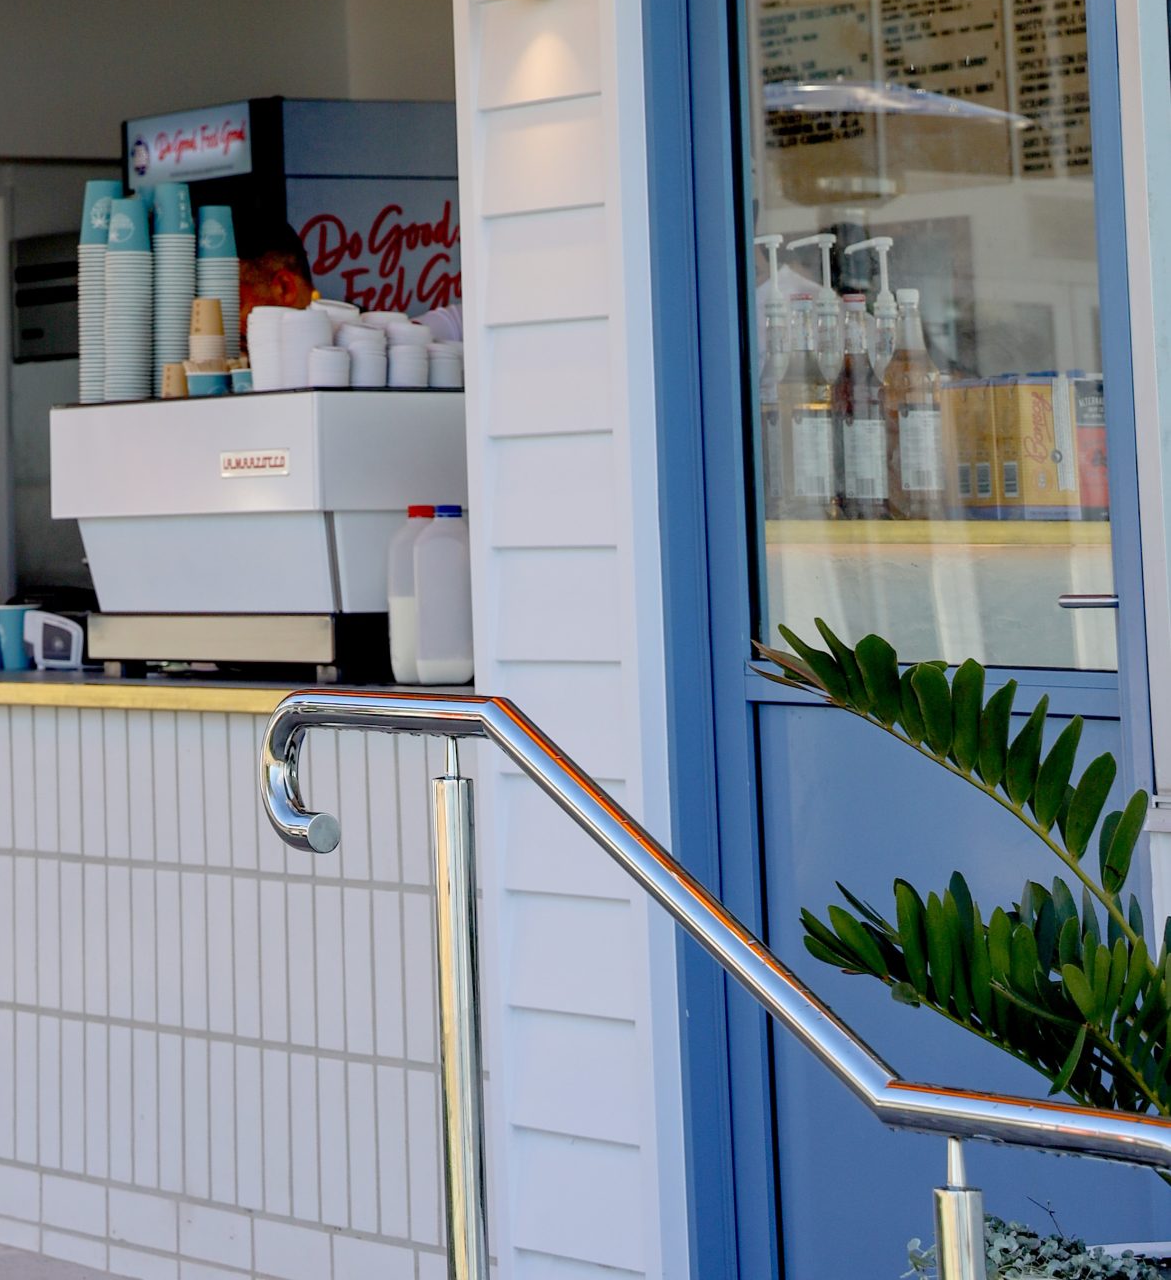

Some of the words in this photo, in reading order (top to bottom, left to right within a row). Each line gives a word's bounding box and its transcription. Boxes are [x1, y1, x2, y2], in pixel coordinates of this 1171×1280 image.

[302, 214, 361, 276] Do
[340, 267, 413, 314] Feel
[1022, 392, 1053, 465] Bonsoy
